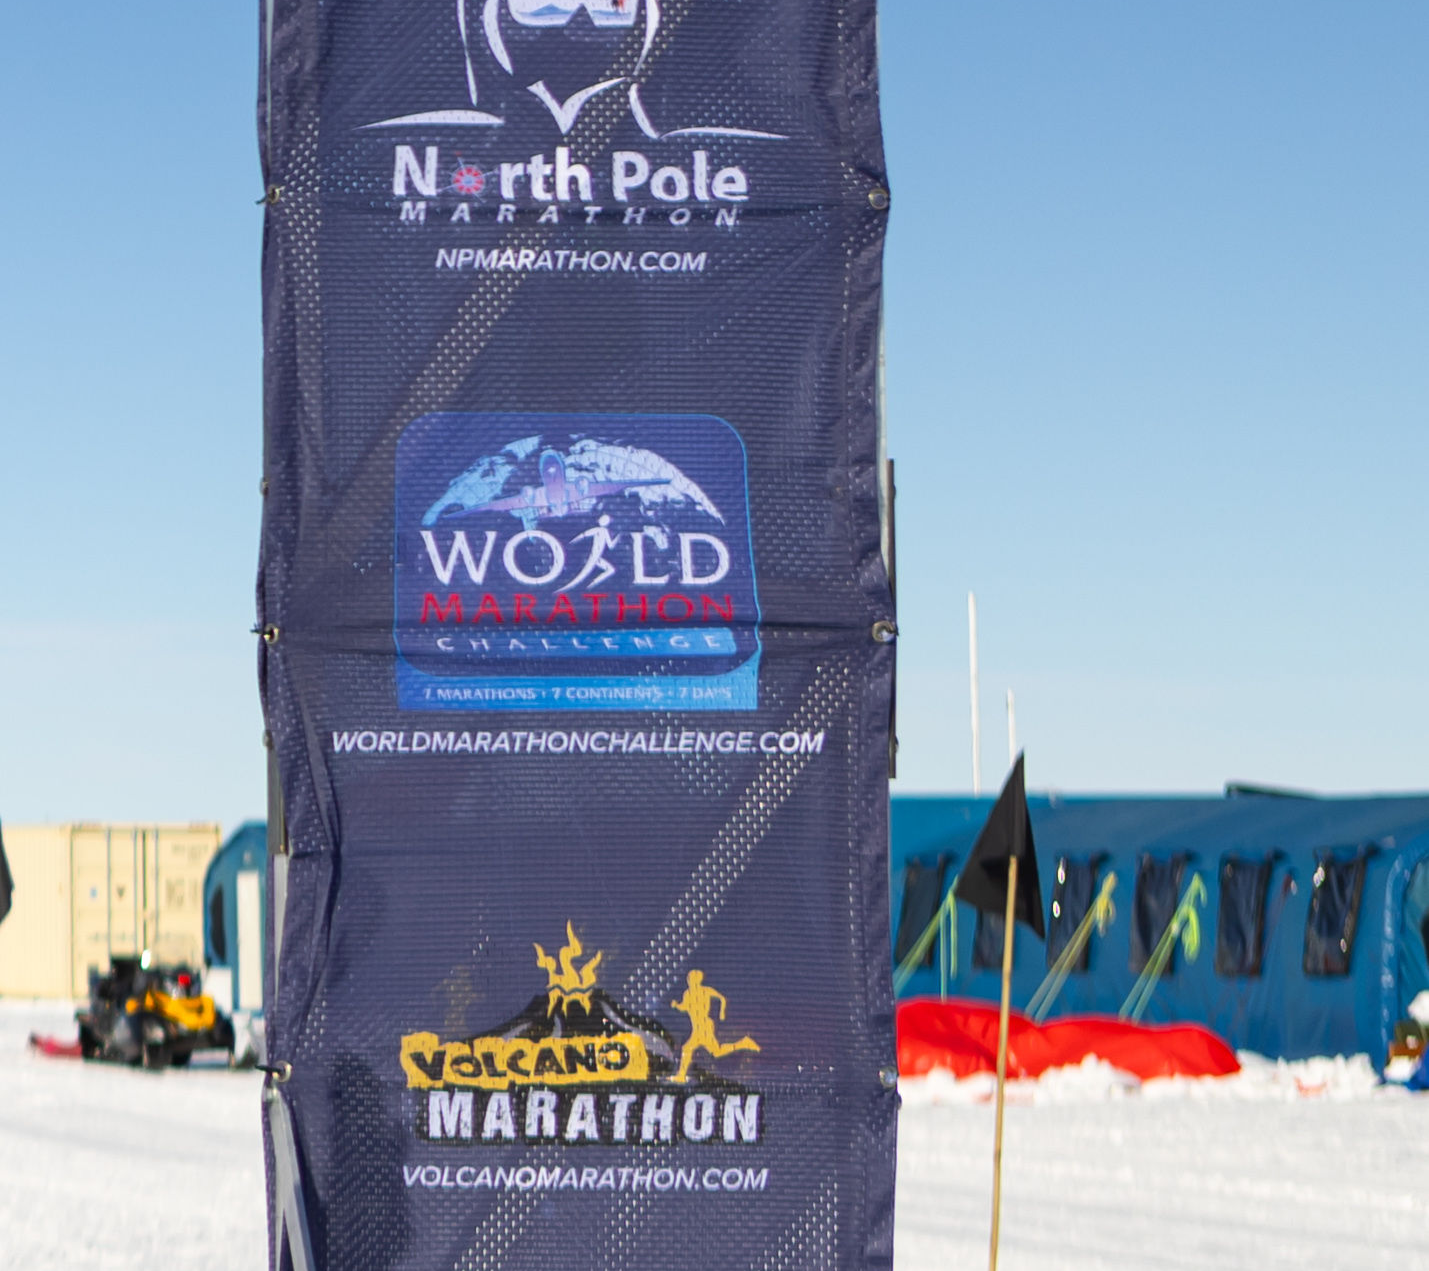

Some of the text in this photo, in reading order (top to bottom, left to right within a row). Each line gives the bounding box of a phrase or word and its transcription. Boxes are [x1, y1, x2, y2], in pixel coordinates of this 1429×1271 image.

[612, 150, 749, 202] Pole
[399, 202, 740, 227] MARATHON
[435, 248, 707, 272] NPMARATHON.COM
[419, 593, 734, 625] MARATHON
[436, 634, 722, 652] CHALLENGE
[332, 730, 826, 756] WORLDMARATHONCHALLENGE.COM
[411, 1041, 632, 1081] VOLCANO
[427, 1091, 761, 1143] MARATHON
[402, 1165, 770, 1192] VOLCANOMARATHON.COM
